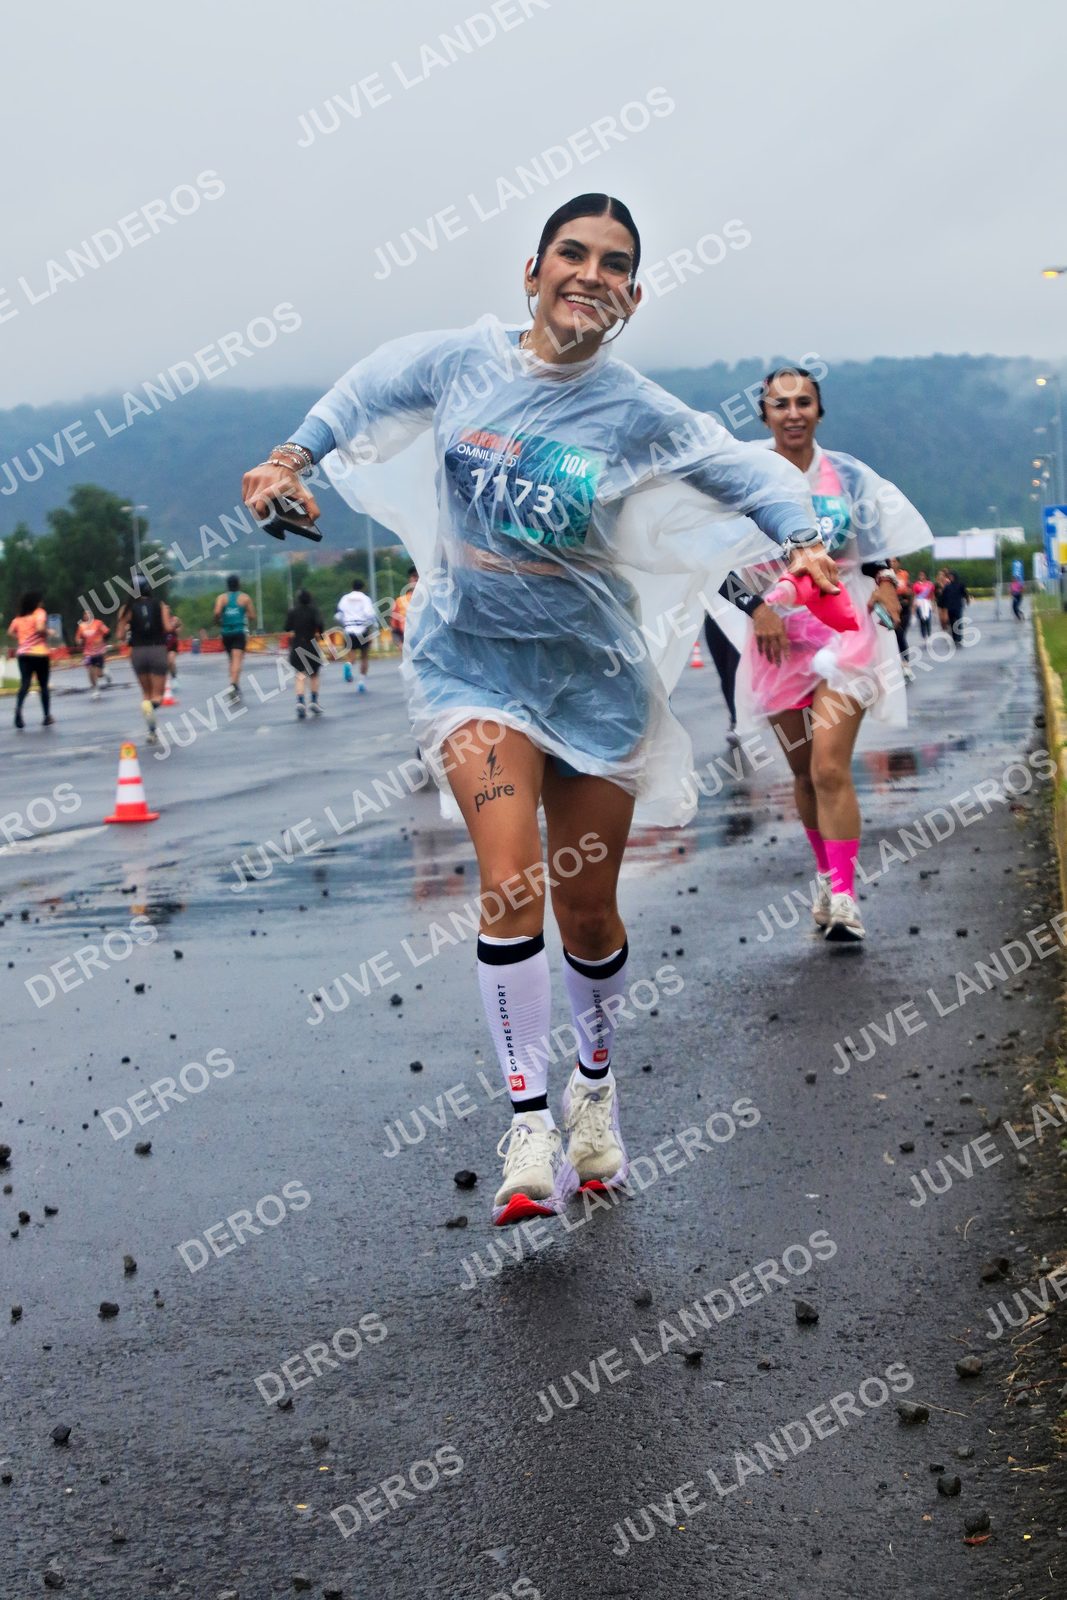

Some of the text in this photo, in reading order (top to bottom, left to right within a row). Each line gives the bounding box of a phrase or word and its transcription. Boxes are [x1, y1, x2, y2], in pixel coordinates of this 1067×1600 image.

[560, 453, 591, 479] 10K
[470, 468, 555, 514] 1173
[497, 984, 518, 1072] COMPRESSPORT
